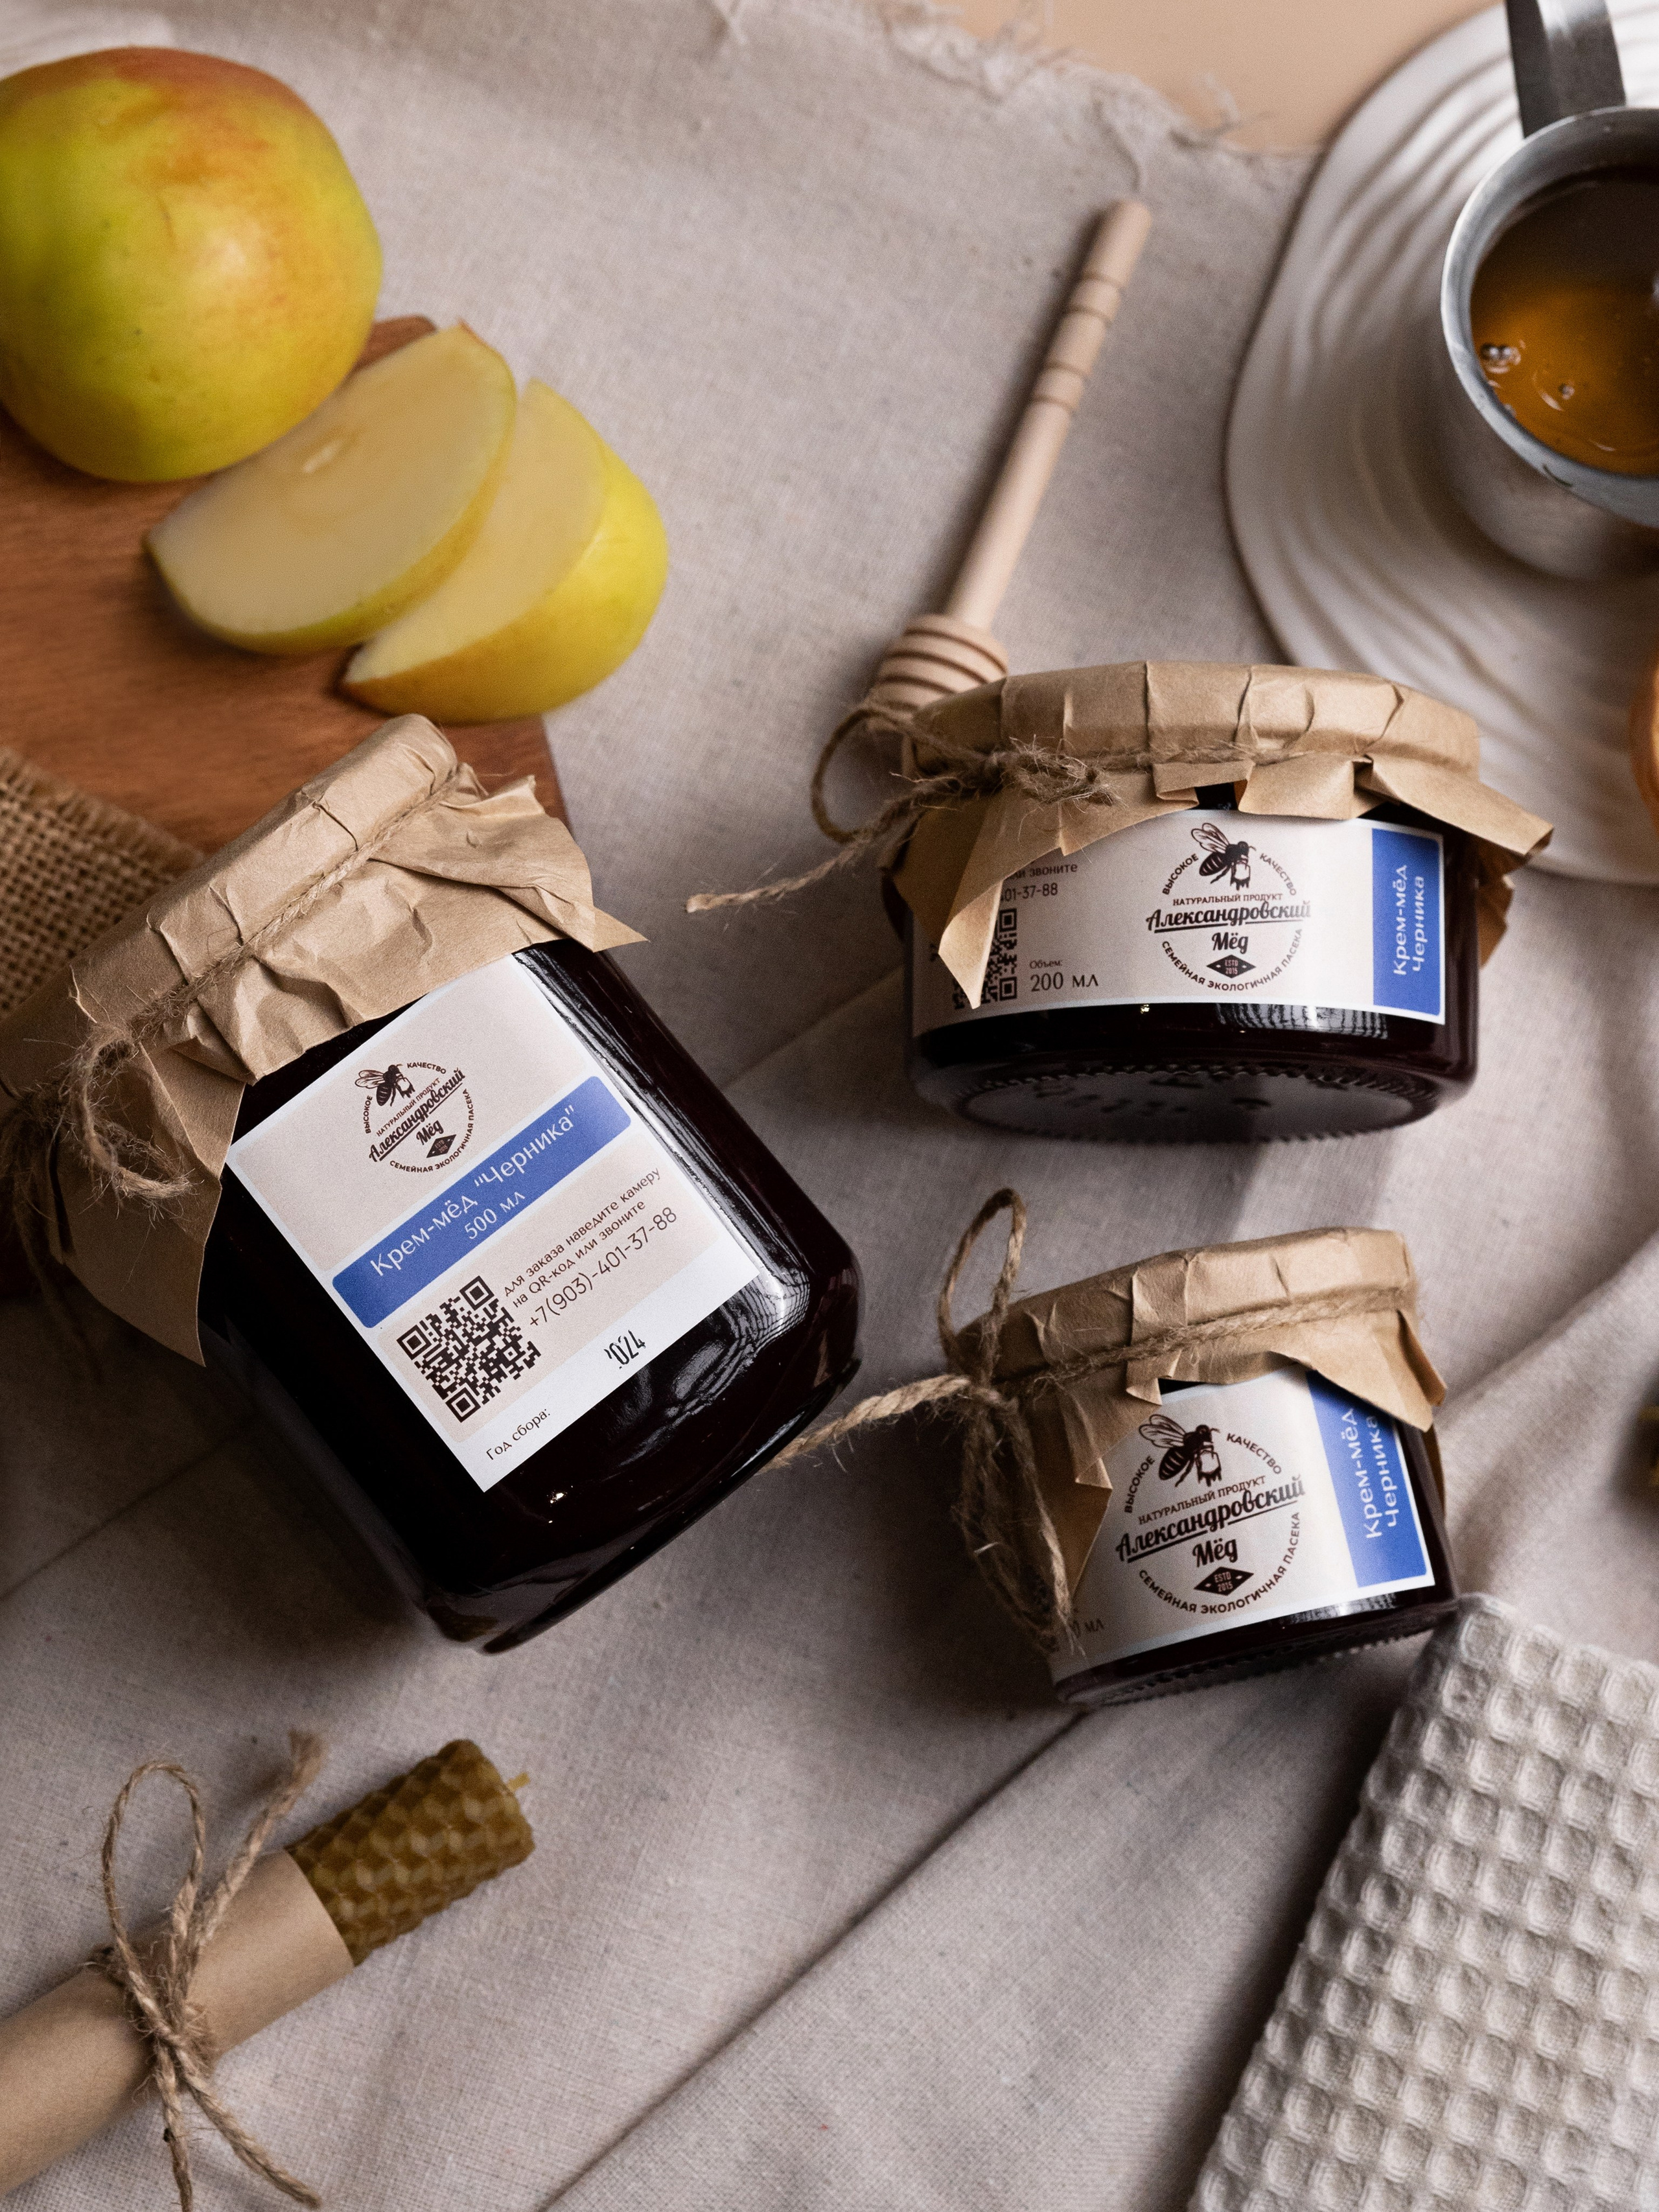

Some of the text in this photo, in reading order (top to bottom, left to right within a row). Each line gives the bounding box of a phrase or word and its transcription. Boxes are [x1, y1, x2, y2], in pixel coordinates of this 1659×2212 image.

[1029, 864, 1078, 878] звоните
[1162, 853, 1297, 896] ВЫСОКОЕ КАЧЕСТВО
[1172, 893, 1283, 906] НАТУРАЛЬНЫЙ ПРОДУКТ
[1146, 900, 1311, 931] Александровский
[1211, 932, 1249, 955] Мёд
[1393, 865, 1411, 975] Крем-мёд
[1411, 876, 1428, 972] Черника
[1029, 959, 1063, 970] Объем:
[1030, 972, 1099, 992] 200 мл
[1162, 928, 1303, 992] СЕМЕЙНАЯ ЭКОЛОГИЧНАЯ ПАСЕКА
[363, 1062, 447, 1134] ВЫСОКОЕ КАЧЕСТВО
[369, 1067, 466, 1163] Александровский
[377, 1077, 441, 1137] НАТУРАЛЬНЫЙ ПРОДУКТ
[389, 1088, 474, 1173] СЕМЕЙНАЯ ЭКОЛОГИЧНАЯ ПАСЕКА
[415, 1120, 445, 1146] Мёд
[370, 1104, 575, 1277] Крем-мёд "Черника"
[465, 1191, 526, 1240] 500 мл
[504, 1167, 661, 1297] для заказа наведите камеру
[513, 1200, 645, 1308] на QR-код или звоните
[529, 1207, 677, 1327] +7(903)-401-37-88
[486, 1408, 551, 1460] Год сбора:
[1124, 1432, 1282, 1514] ВЫСОКОЕ КАЧЕСТВО
[1138, 1475, 1266, 1525] НАТУРАЛЬНЫЙ ПРОДУКТ
[1341, 1408, 1383, 1539] Крем-мёд
[1365, 1415, 1400, 1528] Черника
[1115, 1473, 1306, 1563] Александровский
[1139, 1512, 1301, 1614] СЕМЕЙНАЯ ЭКОЛОГИЧНАЯ ПАСЕКА
[1192, 1537, 1239, 1568] Мёд
